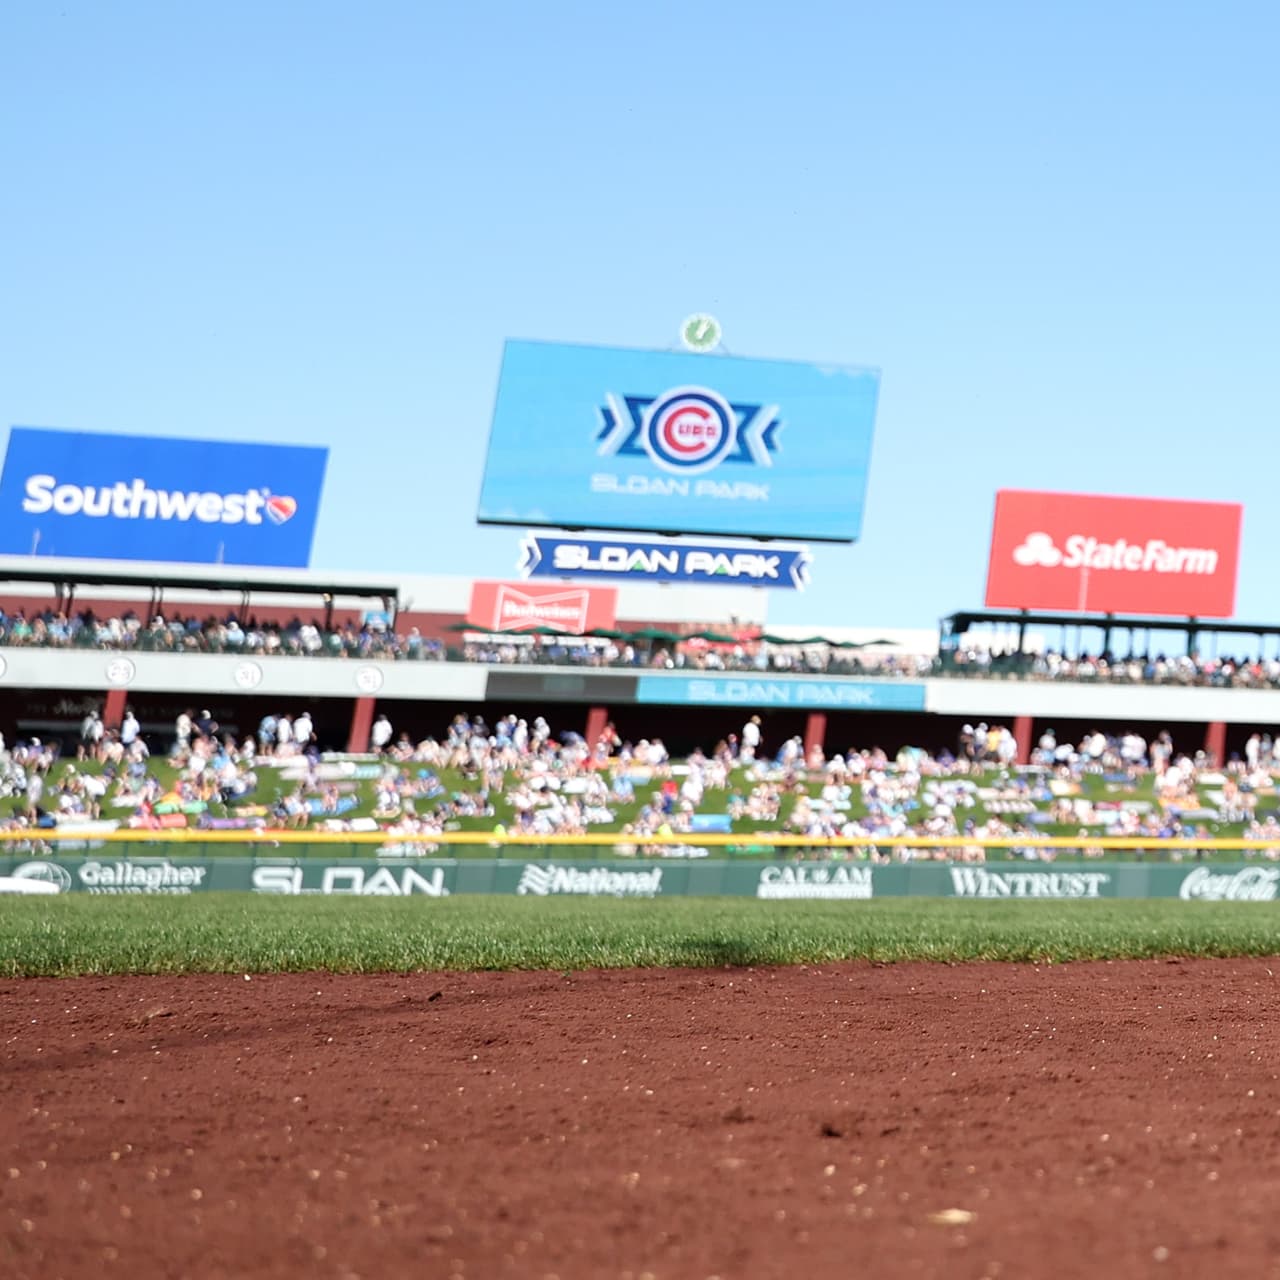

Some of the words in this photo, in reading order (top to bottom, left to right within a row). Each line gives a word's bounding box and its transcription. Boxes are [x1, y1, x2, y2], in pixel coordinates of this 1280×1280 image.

[22, 474, 265, 525] Southwest
[591, 473, 689, 497] SLOAN
[695, 478, 772, 502] PARK
[553, 544, 679, 574] SLOAN
[684, 551, 780, 579] PARK
[688, 680, 790, 703] SLOAN
[797, 685, 874, 705] PARK
[79, 861, 206, 889] Gallagher
[252, 866, 445, 896] SLOAN
[551, 866, 663, 895] National
[951, 867, 1103, 897] WINTRUST
